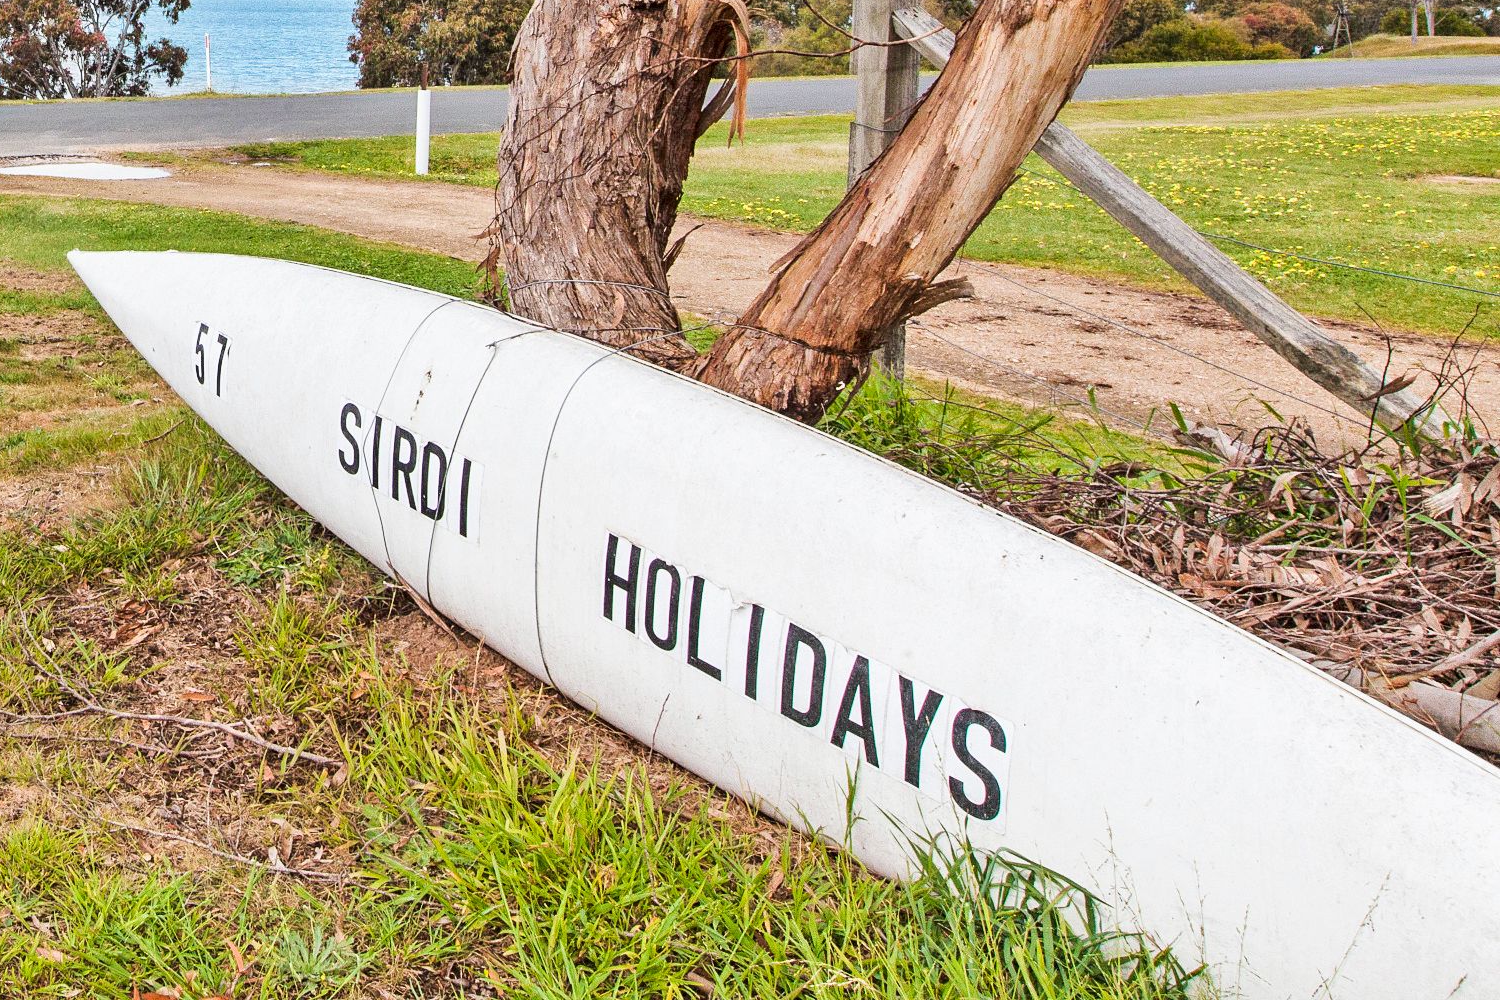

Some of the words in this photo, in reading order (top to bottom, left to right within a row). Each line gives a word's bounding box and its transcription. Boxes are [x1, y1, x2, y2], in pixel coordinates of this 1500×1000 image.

[195, 322, 228, 397] 57
[338, 403, 471, 538] SIRDI
[603, 532, 1007, 821] HOLIDAYS
